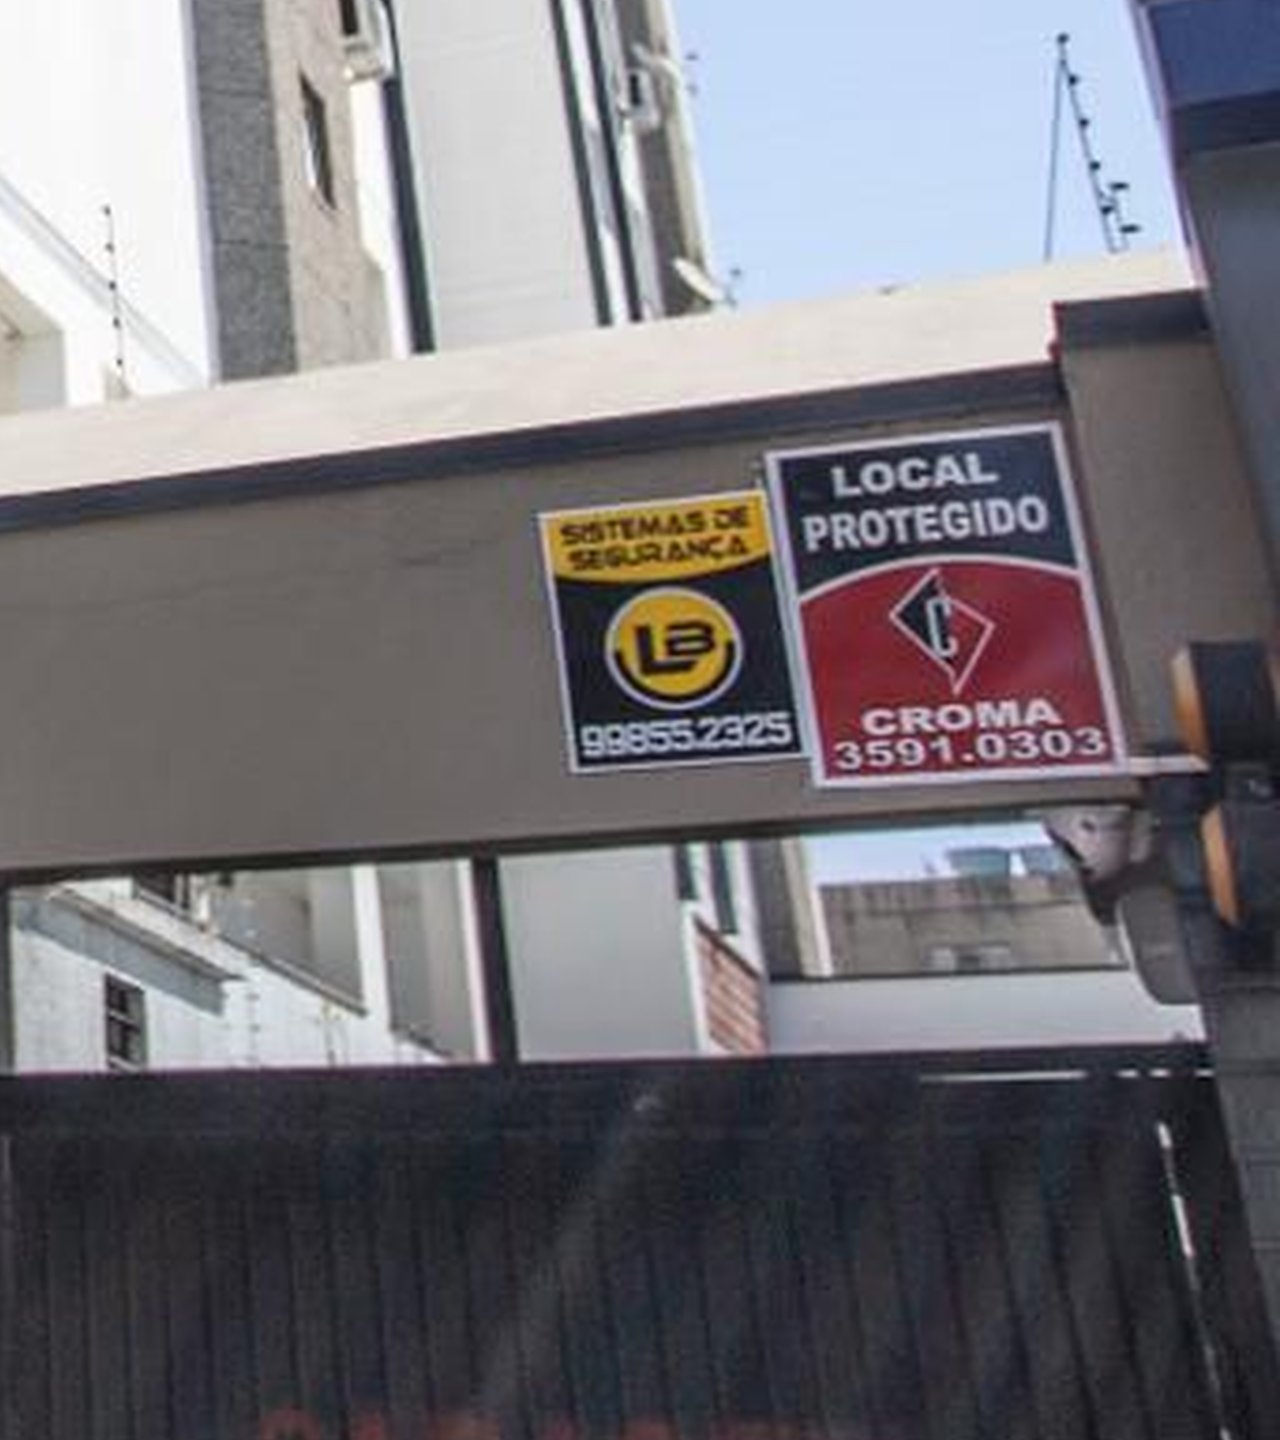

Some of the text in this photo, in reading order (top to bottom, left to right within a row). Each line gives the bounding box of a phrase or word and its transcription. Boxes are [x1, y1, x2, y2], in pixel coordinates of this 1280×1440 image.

[831, 452, 999, 498] LOCAL
[559, 505, 750, 546] SISTEMAS DE
[802, 494, 1049, 553] PROTEGIDO
[567, 534, 748, 571] SEGURANÇA
[860, 697, 1063, 737] CROMA
[833, 727, 1107, 771] 3591.0303
